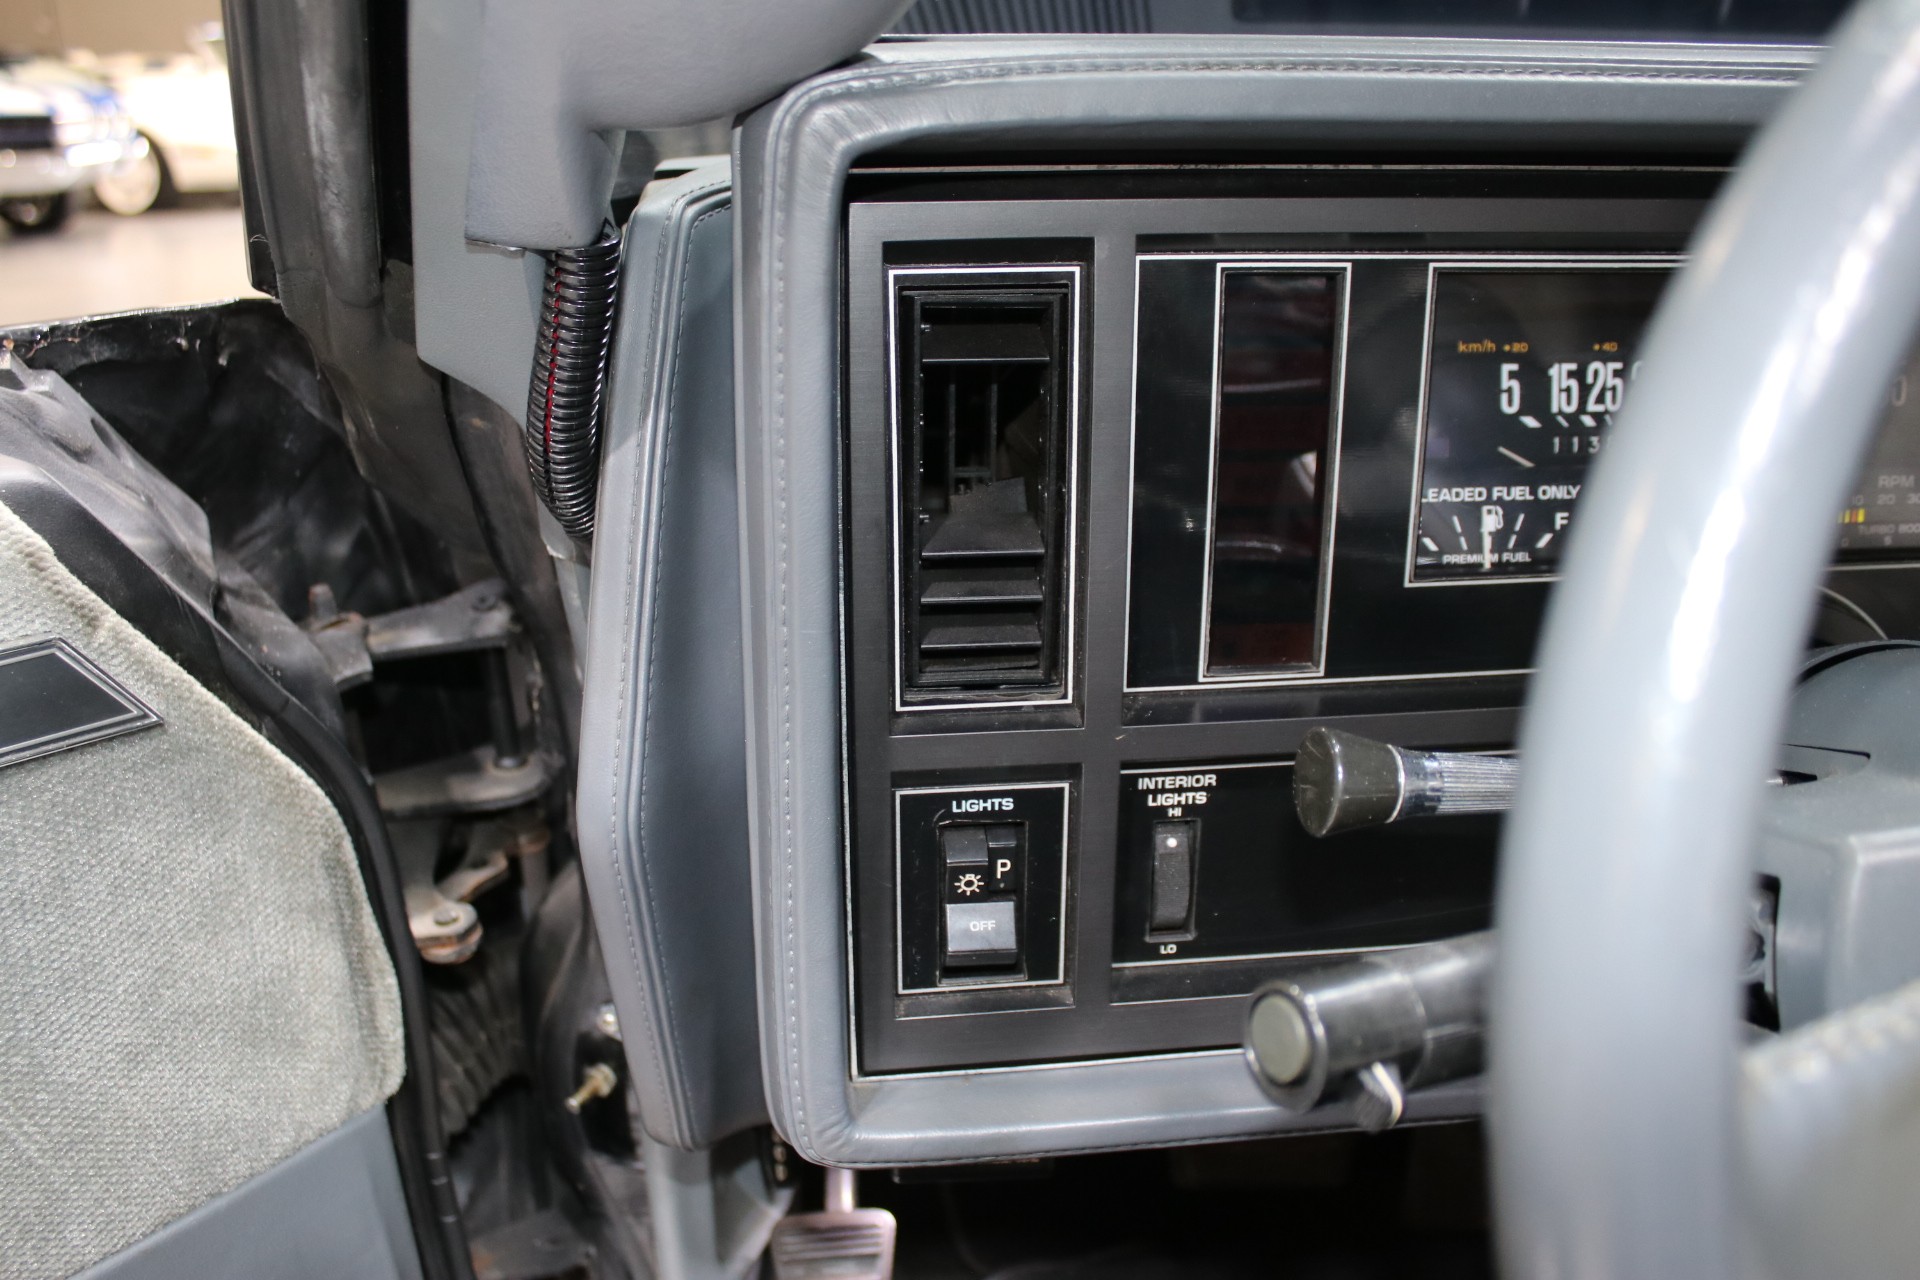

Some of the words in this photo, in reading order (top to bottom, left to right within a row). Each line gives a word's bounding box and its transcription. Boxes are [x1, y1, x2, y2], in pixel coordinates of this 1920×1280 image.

[1458, 340, 1496, 353] km/h
[1500, 363, 1521, 415] 5
[1548, 362, 1580, 414] 15
[1586, 360, 1624, 412] 25
[1878, 475, 1915, 488] RPM
[1492, 486, 1534, 501] FUEL
[1538, 485, 1581, 500] ONLY
[1554, 512, 1569, 531] F
[1502, 551, 1532, 562] FUEL
[1138, 774, 1217, 790] INTERIOR
[951, 797, 1015, 813] LIGHTS
[1147, 791, 1207, 807] LIGHTS
[1167, 806, 1182, 817] HI
[996, 859, 1011, 879] P
[969, 920, 996, 931] OFF
[1160, 944, 1177, 955] LO
